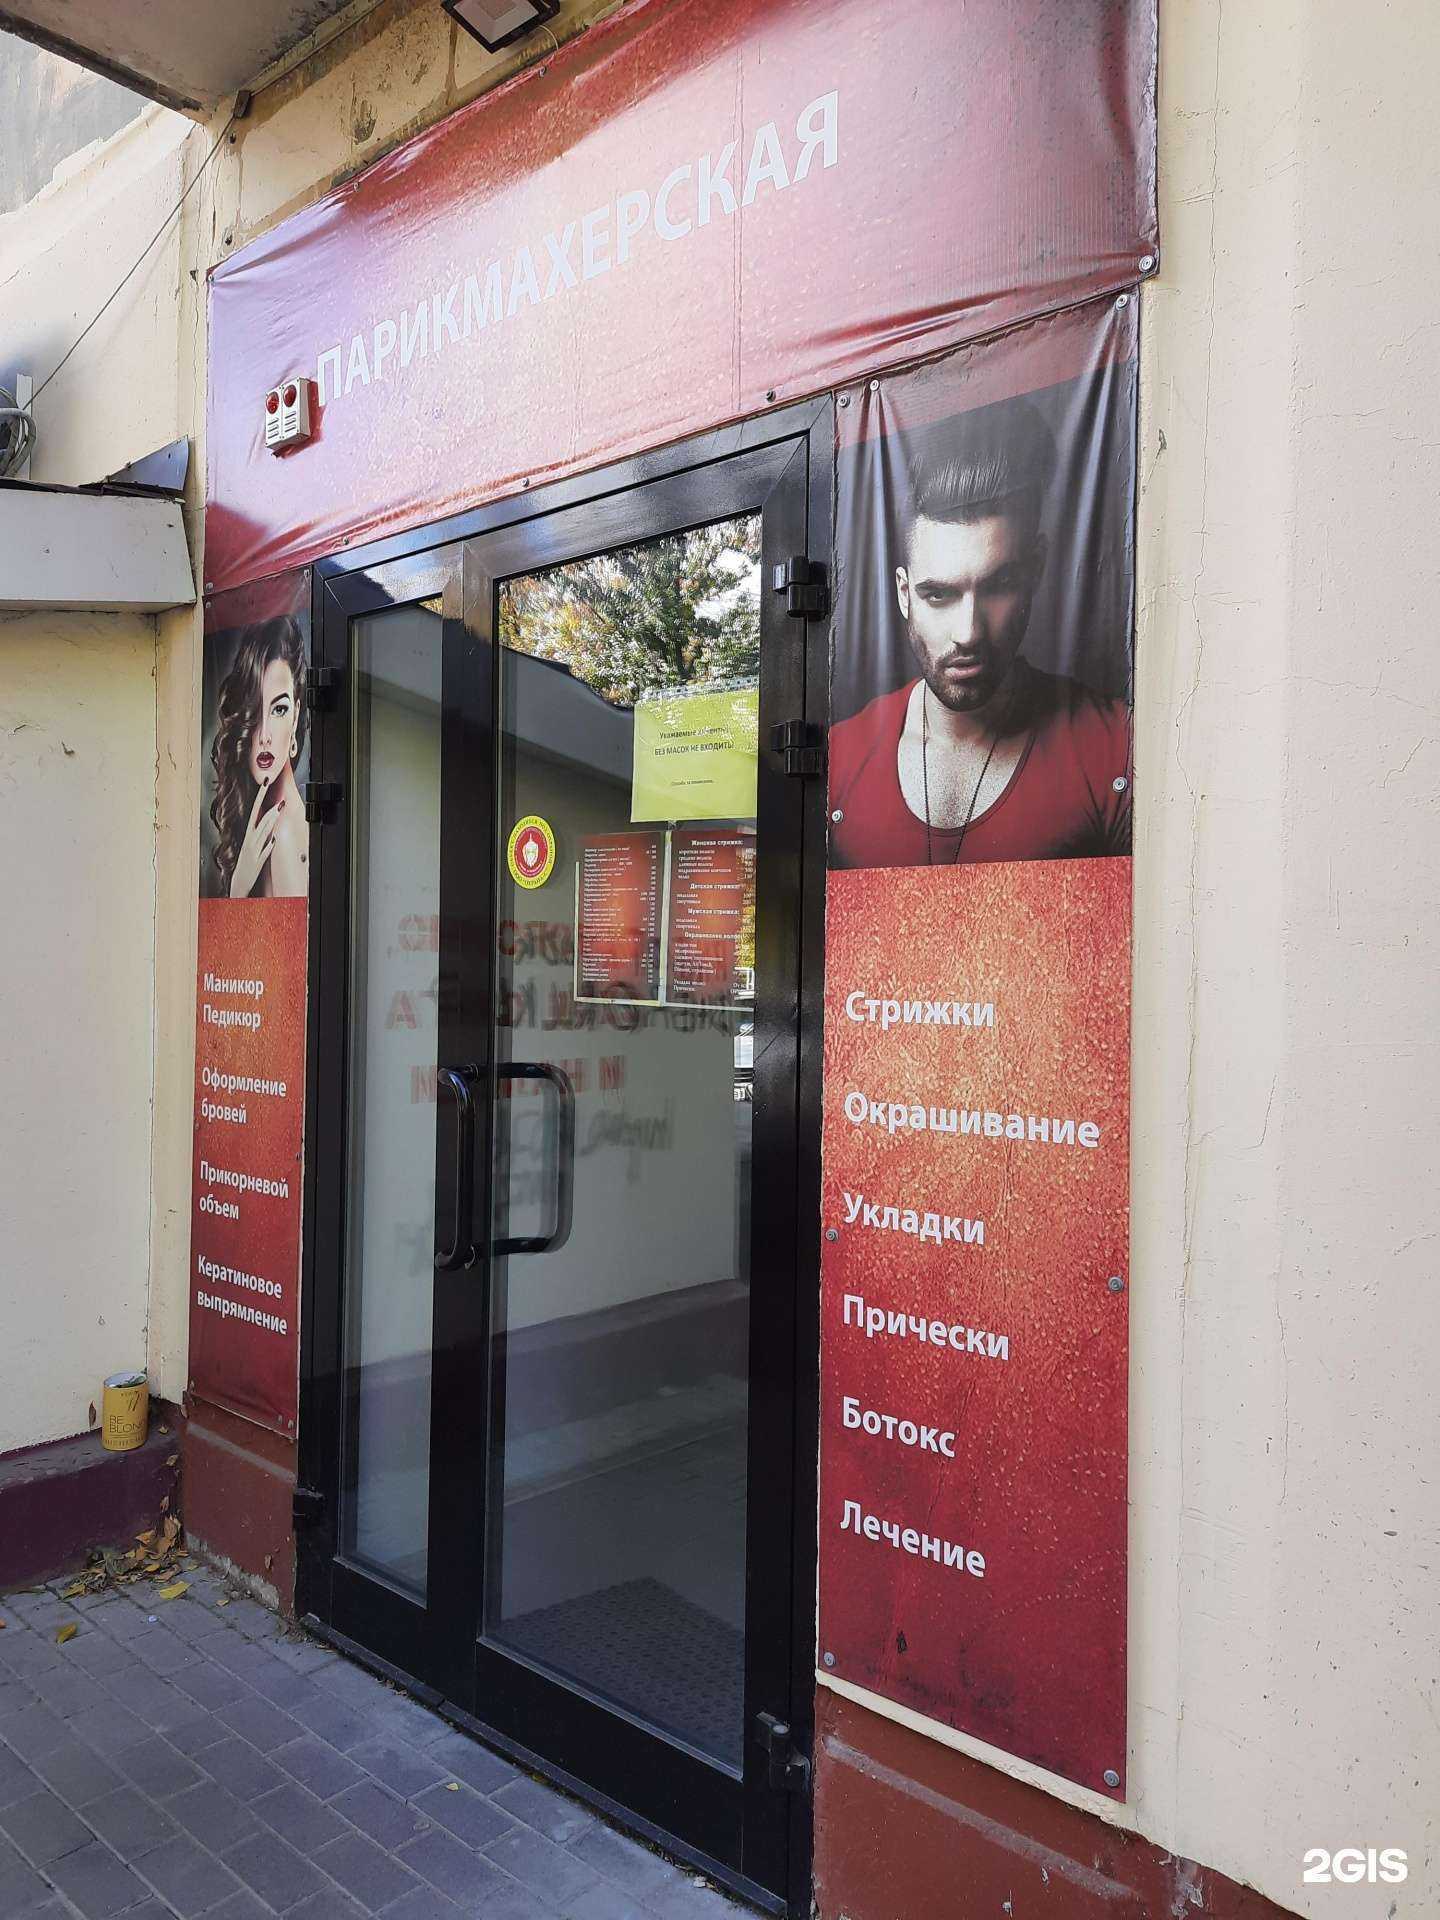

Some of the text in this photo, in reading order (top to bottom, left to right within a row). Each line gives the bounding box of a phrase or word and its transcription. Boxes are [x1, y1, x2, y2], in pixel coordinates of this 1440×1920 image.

[316, 90, 839, 406] ПАРИКМАХЕРСКАЯ
[655, 748, 665, 756] БЕЗ
[666, 745, 690, 755] МАСОК
[690, 744, 699, 752] НЕ
[203, 973, 264, 1000] Маникюр
[203, 1004, 261, 1030] Педикюр
[845, 991, 994, 1030] Стрижки
[202, 1067, 287, 1098] Оформление
[201, 1098, 247, 1125] бровей
[844, 1091, 1100, 1148] Окрашивание
[200, 1161, 289, 1199] Прикорневой
[199, 1194, 239, 1220] объем
[843, 1192, 985, 1245] Укладки
[198, 1255, 282, 1299] Кератиновое
[197, 1292, 287, 1335] выпрямление
[842, 1294, 1009, 1360] Прически
[842, 1396, 955, 1458] Ботокс
[840, 1500, 986, 1578] Лечение
